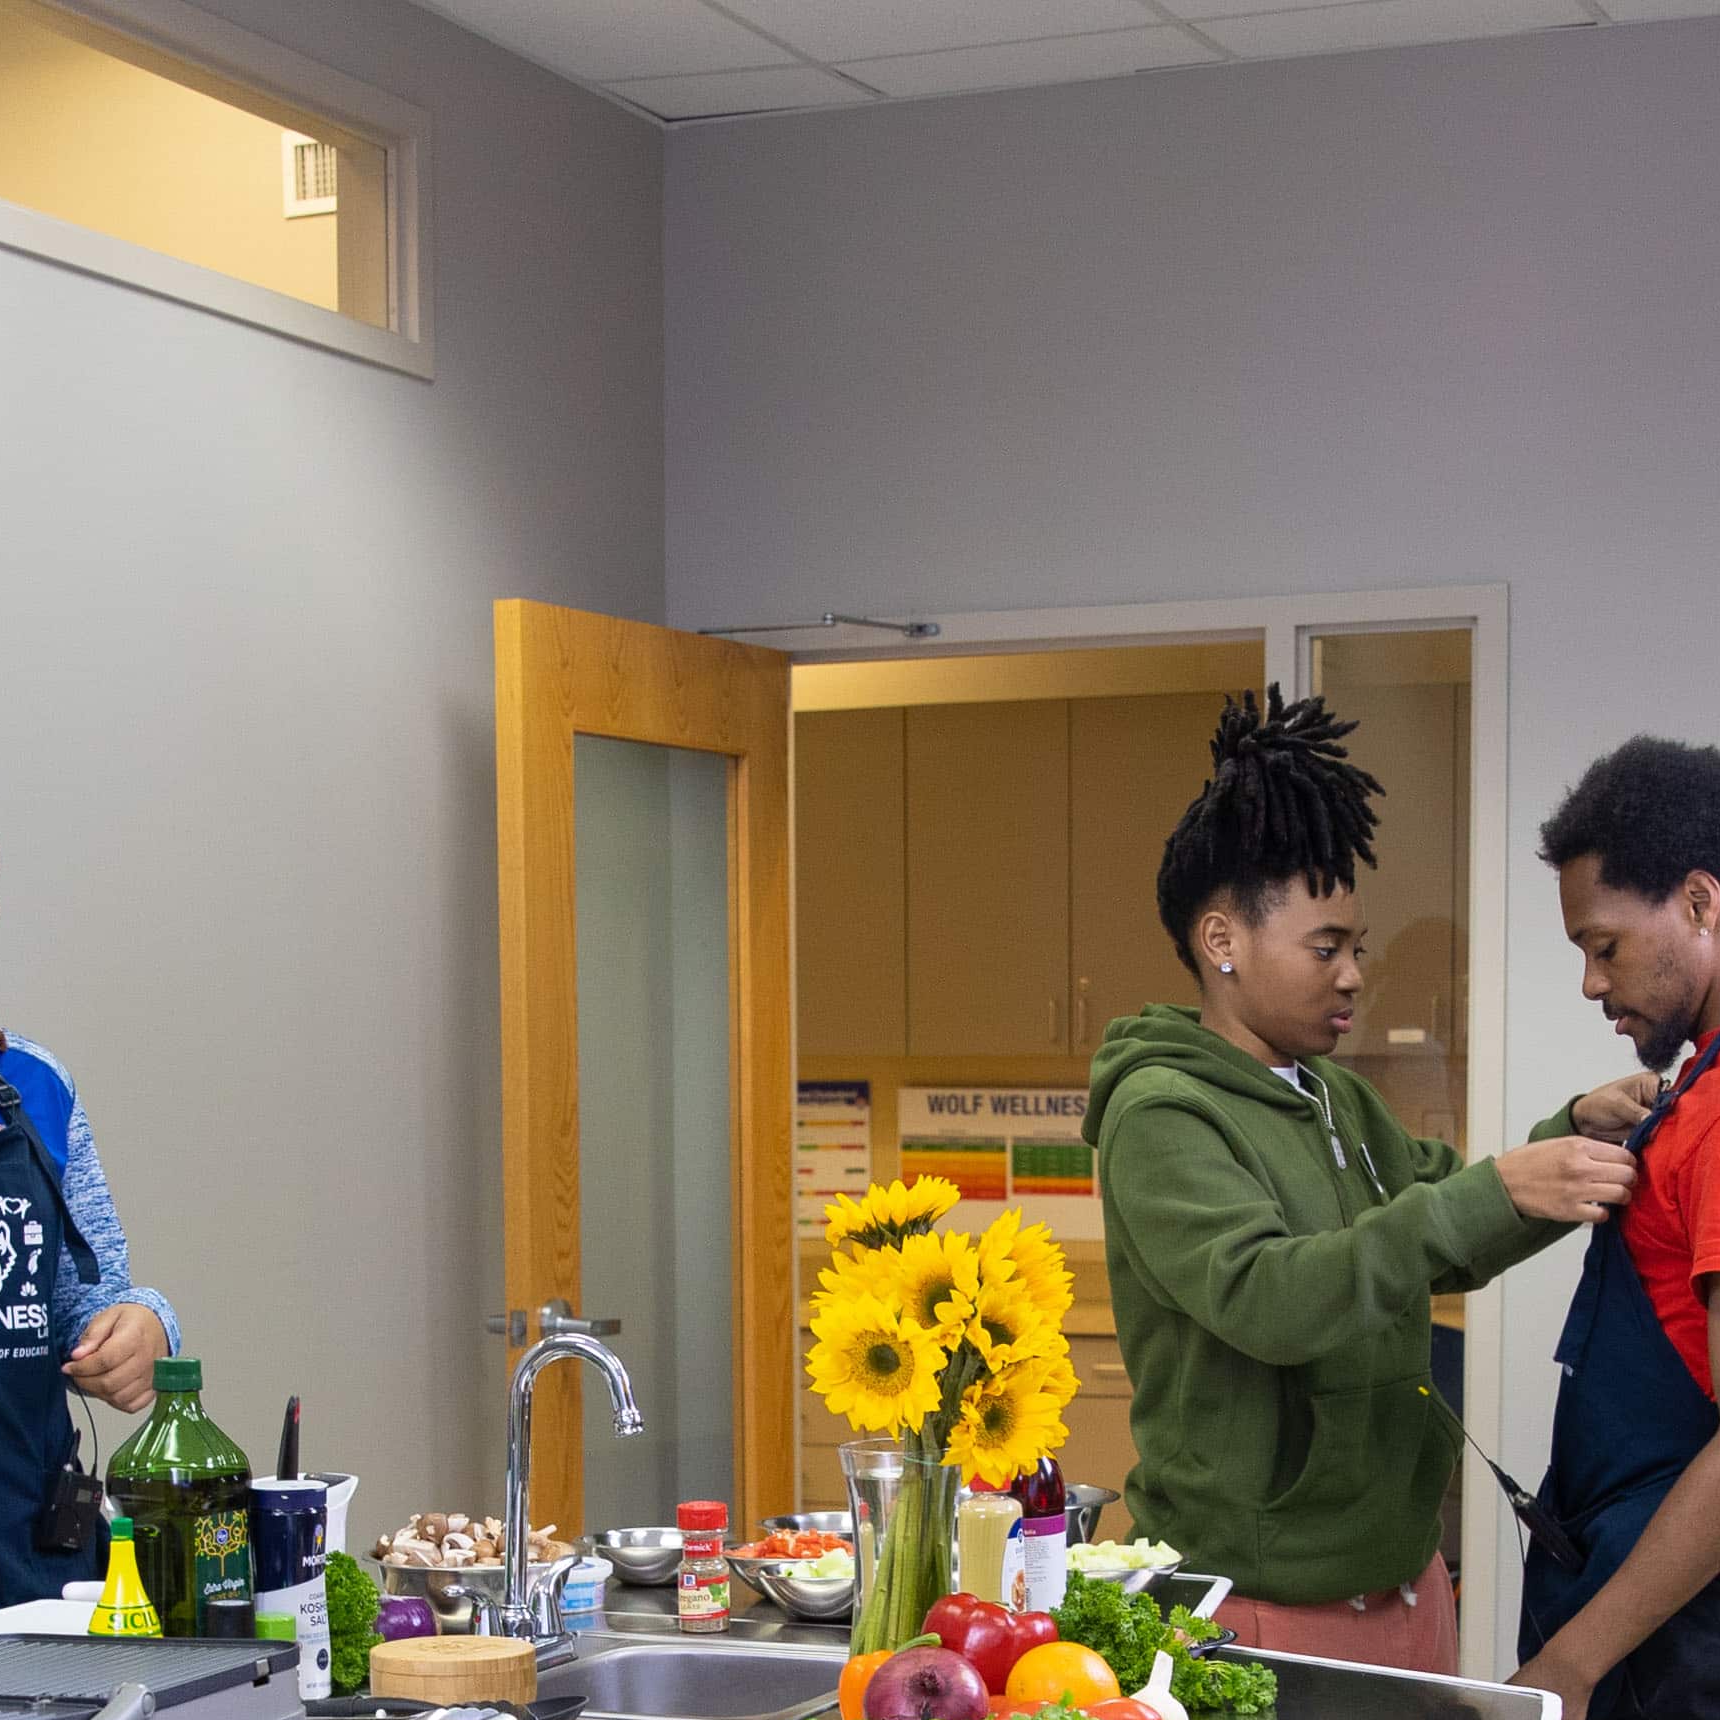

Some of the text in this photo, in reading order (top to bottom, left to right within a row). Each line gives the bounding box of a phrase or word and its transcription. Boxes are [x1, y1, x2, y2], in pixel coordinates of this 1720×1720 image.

[927, 1095, 1086, 1117] WOLF WELLNES
[685, 1543, 712, 1552] Cormick
[680, 1594, 710, 1603] regano
[300, 1601, 328, 1614] KOSH
